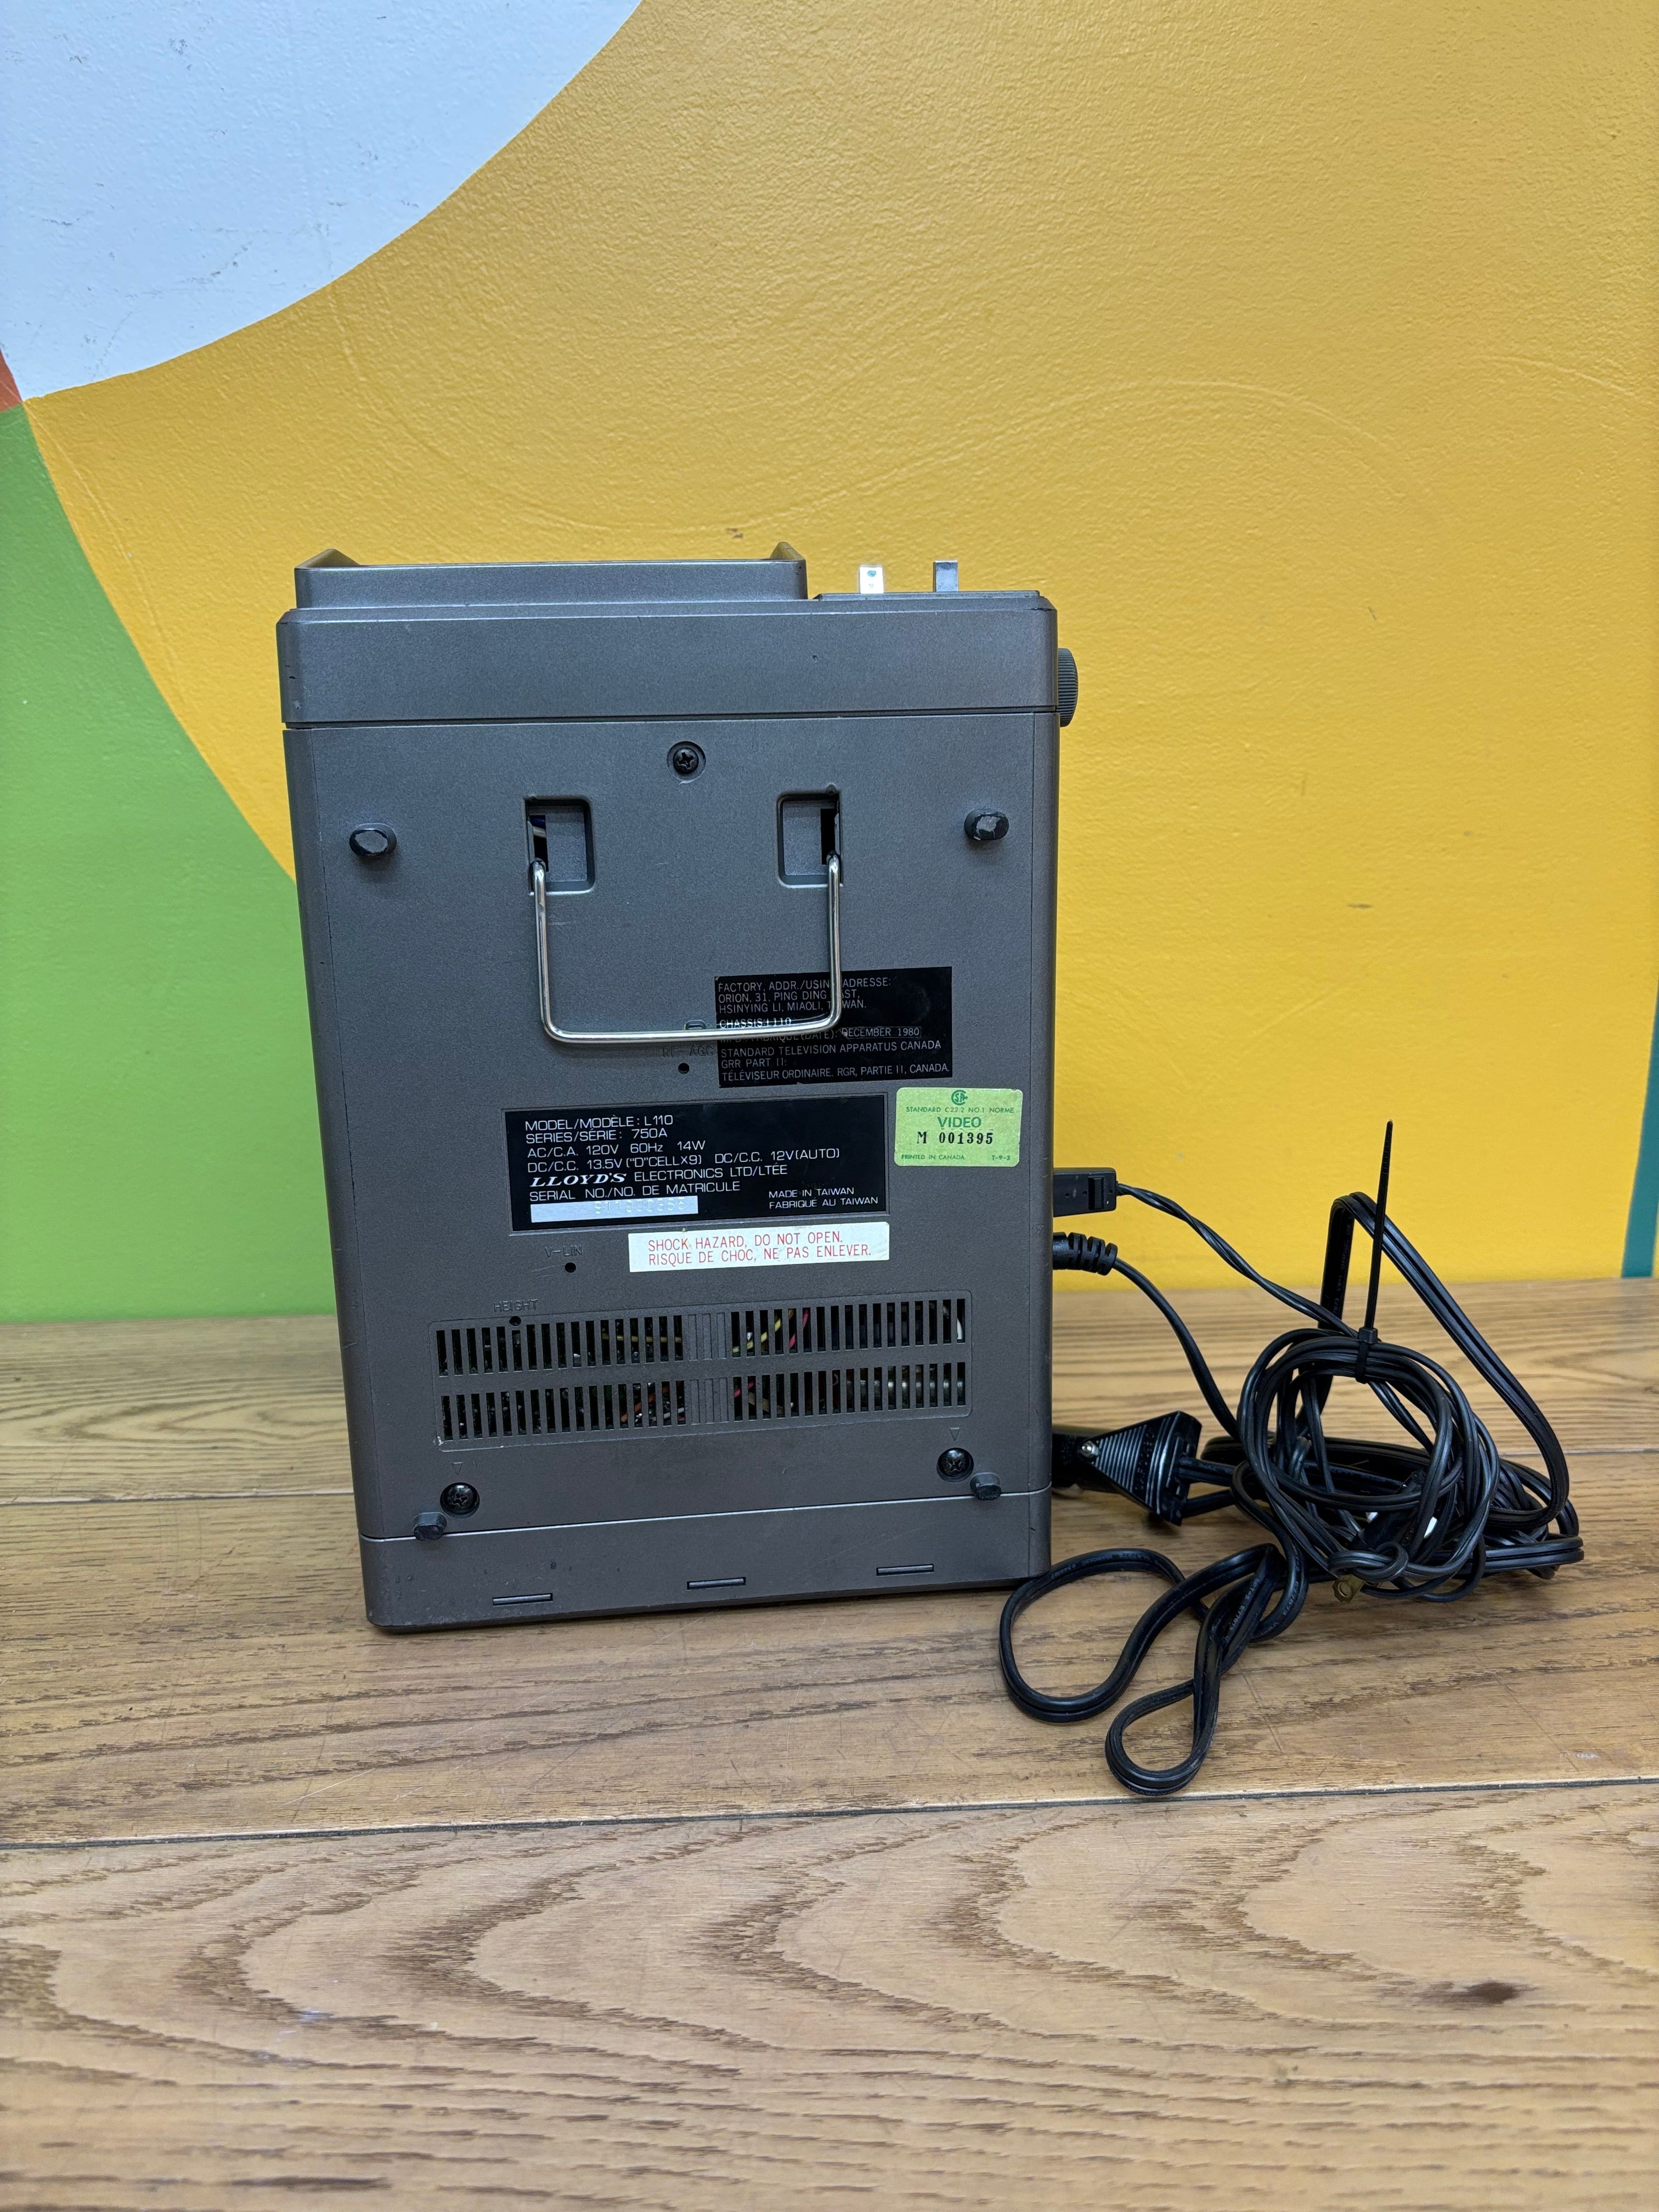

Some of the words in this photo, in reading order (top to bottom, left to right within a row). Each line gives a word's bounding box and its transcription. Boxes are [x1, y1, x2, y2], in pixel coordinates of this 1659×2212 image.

[718, 981, 765, 992] FACTORY,
[769, 979, 830, 991] ADDR./USIN
[843, 977, 891, 988] ADRESSE:
[718, 994, 752, 1003] ORION,
[774, 991, 797, 1001] PING
[803, 990, 827, 1000] DING
[719, 1003, 768, 1014] HSINYING
[772, 1002, 784, 1013] LI,
[787, 1001, 823, 1012] MIAOLI,
[826, 999, 867, 1010] TWAN.
[842, 1028, 891, 1037] DECEMBER
[898, 1028, 920, 1037] 1980
[721, 1048, 775, 1058] STANDARD
[778, 1045, 836, 1056] TELEVISION
[840, 1042, 897, 1053] APPARATUS
[901, 1040, 941, 1051] CANADA
[721, 1059, 741, 1069] GRR
[746, 1058, 771, 1068] PART
[722, 1070, 780, 1081] TÉLÉVISEUR
[837, 1067, 857, 1077] RGR,
[861, 1066, 893, 1076] PARTIE
[910, 1063, 950, 1074] CANADA.
[644, 1115, 673, 1126] L110
[937, 1116, 982, 1128] VIDEO
[631, 1127, 668, 1139] 750A
[917, 1131, 927, 1144] M
[939, 1132, 994, 1144] 001395
[527, 1146, 579, 1158] AC/C.A.
[586, 1144, 619, 1155] 120V
[630, 1143, 663, 1154] 60Hz
[677, 1140, 706, 1151] 14W
[528, 1160, 579, 1173] DC/C.C.
[586, 1159, 622, 1170] 13.5V
[715, 1152, 763, 1164] DC/C.C.
[529, 1173, 627, 1187] LLOYD'S
[634, 1168, 723, 1182] ELECTRONICS
[730, 1163, 788, 1177] LTD/LTÉE
[529, 1190, 575, 1201] SERIAL
[585, 1187, 636, 1198] NO./NO.
[642, 1185, 659, 1195] DE
[666, 1181, 741, 1194] MATRICULE
[769, 1189, 798, 1199] MADE
[802, 1189, 812, 1197] IN
[817, 1187, 854, 1196] TAIWAN
[840, 1197, 878, 1206] TAIWAN
[648, 1238, 689, 1252] SHOCK
[695, 1235, 747, 1250] HAZARD,
[754, 1234, 770, 1246] DO
[777, 1233, 800, 1245] NOT
[808, 1231, 843, 1244] OPEN.
[648, 1251, 692, 1267] RISQUE
[699, 1250, 714, 1263] DE
[721, 1249, 757, 1263] CHOC,
[764, 1247, 779, 1260] NE
[787, 1246, 809, 1259] PAS
[816, 1244, 871, 1258] ENLEVER.
[493, 1298, 539, 1312] HEIGHT
